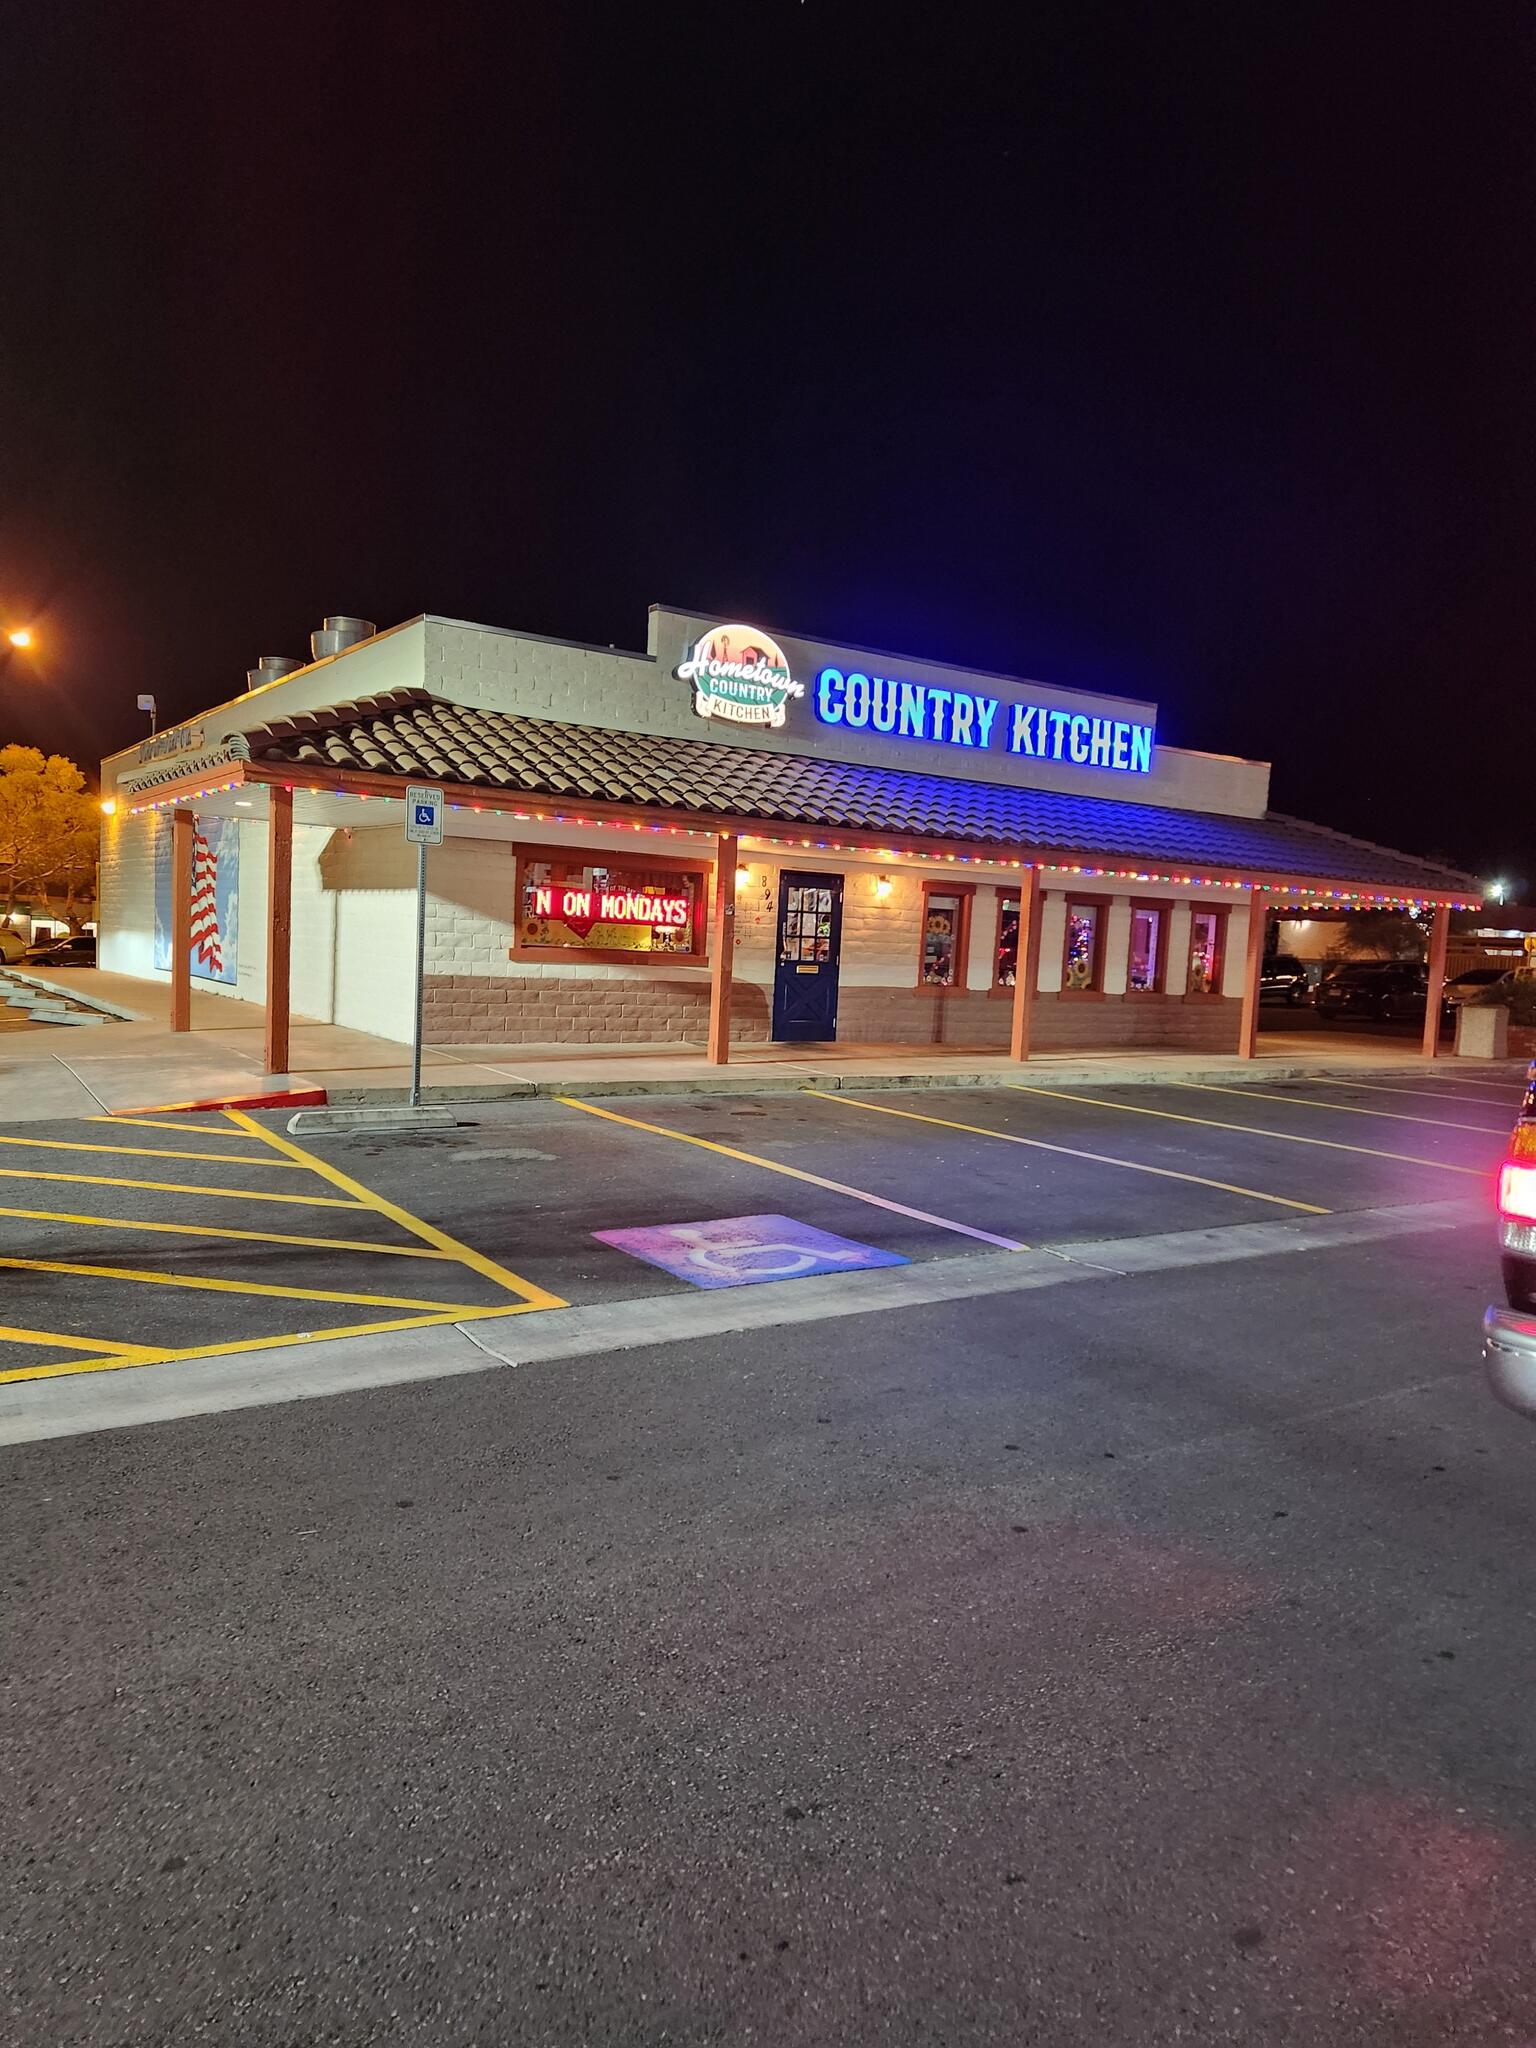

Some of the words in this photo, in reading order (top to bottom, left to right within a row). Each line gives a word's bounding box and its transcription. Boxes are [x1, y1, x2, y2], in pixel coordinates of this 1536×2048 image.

[677, 639, 805, 698] Hometown
[709, 678, 774, 702] COUNTRY
[713, 698, 770, 720] KITCHEN
[816, 668, 999, 749] COUNTRY
[1010, 703, 1153, 773] KITCHEN
[410, 791, 440, 800] RESERVED
[412, 798, 438, 806] PARKING
[563, 892, 590, 917] ON
[601, 895, 687, 924] MONDAYS
